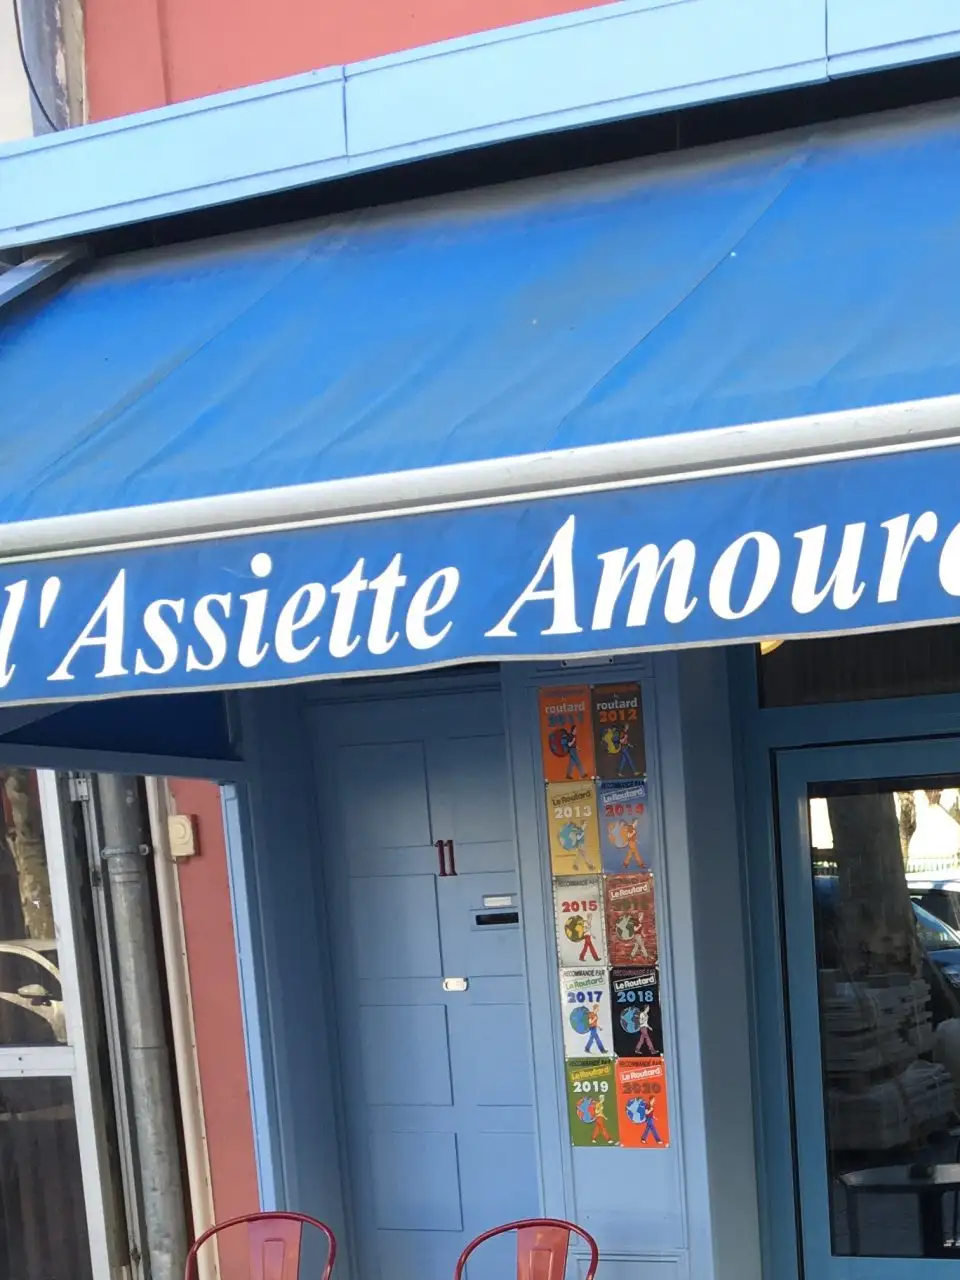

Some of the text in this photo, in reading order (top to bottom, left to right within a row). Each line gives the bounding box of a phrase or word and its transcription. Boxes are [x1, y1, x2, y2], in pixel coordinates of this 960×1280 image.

[545, 701, 586, 714] routard
[596, 697, 638, 710] routard
[600, 710, 637, 723] 2012
[554, 805, 592, 819] 2013
[435, 839, 458, 877] 11
[561, 900, 598, 913] 2015
[566, 990, 603, 1003] 2017
[617, 990, 654, 1003] 2018
[573, 1081, 609, 1092] 2019
